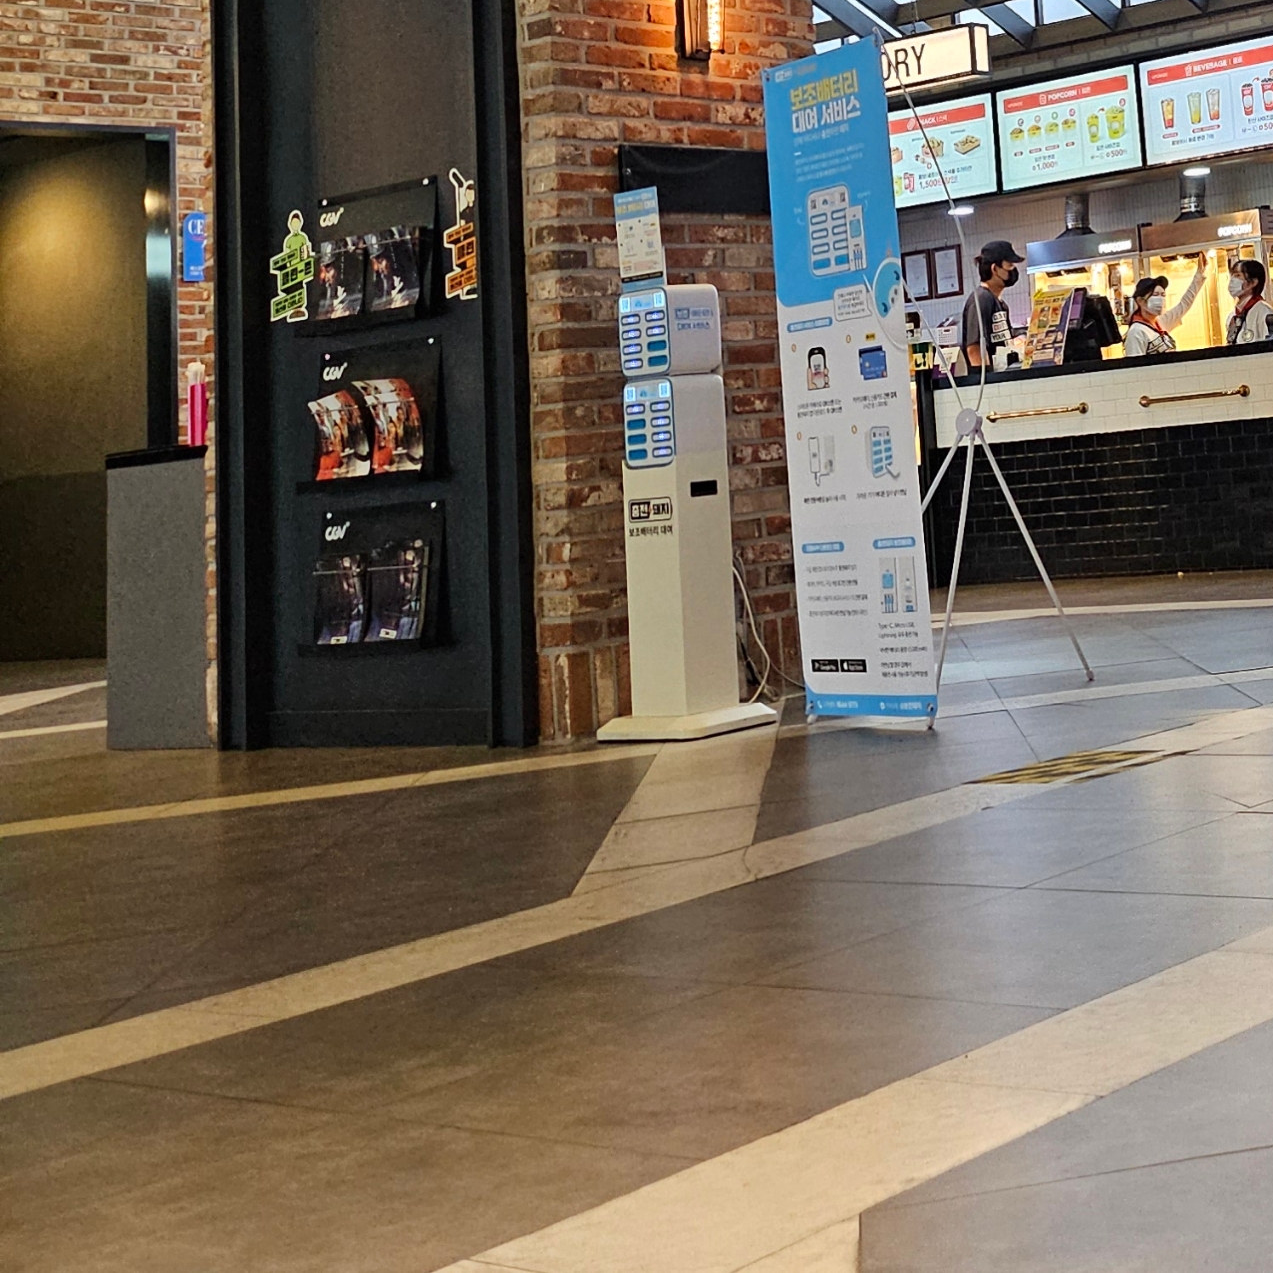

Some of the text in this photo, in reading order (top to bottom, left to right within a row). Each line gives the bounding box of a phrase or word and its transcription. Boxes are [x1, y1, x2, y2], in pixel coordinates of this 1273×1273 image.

[1193, 59, 1227, 73] BEVERAGE
[790, 68, 859, 111] 보조배터리
[1047, 89, 1078, 102] POPCORN
[791, 94, 861, 134] 대여 서비스
[319, 207, 345, 227] CGV
[1217, 223, 1253, 238] POPCORN
[1098, 239, 1132, 254] POPCORN
[322, 362, 348, 381] CGV
[325, 521, 350, 541] CGV
